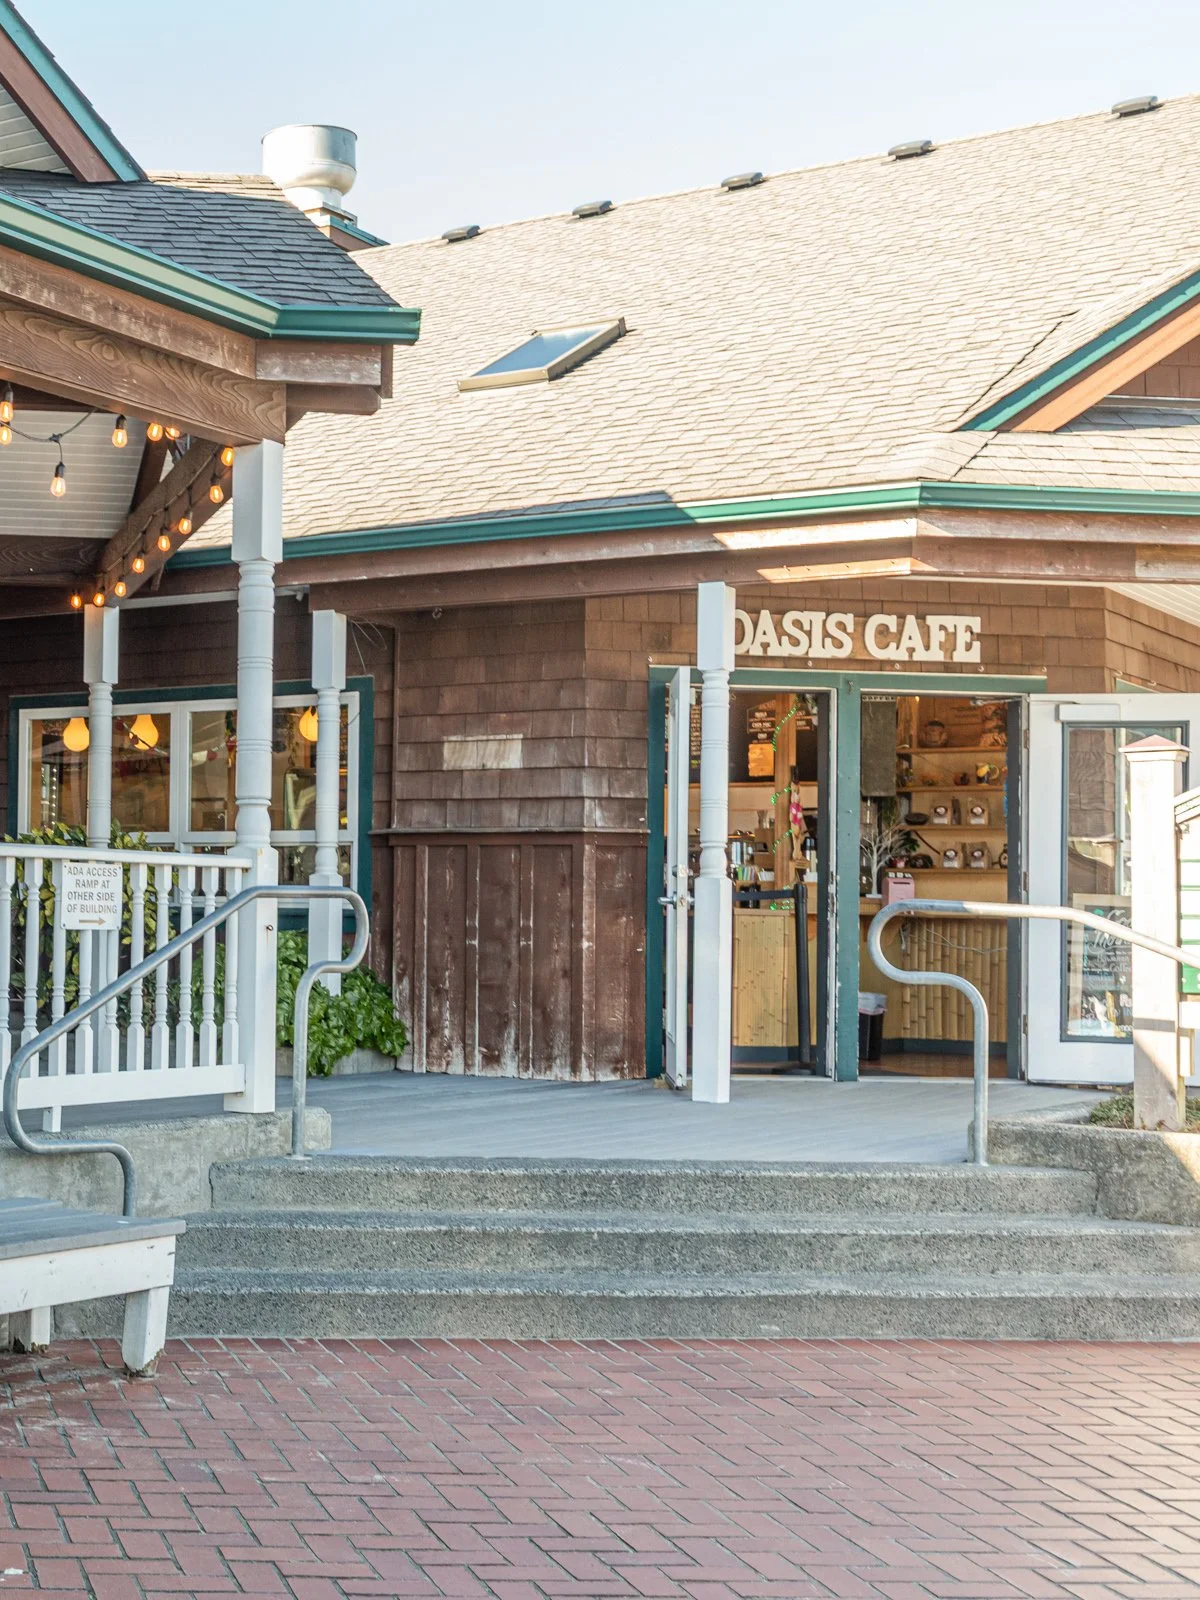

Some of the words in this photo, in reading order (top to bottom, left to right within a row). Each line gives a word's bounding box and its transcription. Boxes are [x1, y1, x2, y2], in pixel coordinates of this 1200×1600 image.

[864, 614, 982, 663] CAFE
[67, 866, 84, 876] ADA
[87, 867, 118, 877] ACCESS
[75, 879, 99, 889] RAMP
[102, 880, 110, 889] AT
[67, 891, 94, 901] OTHER
[96, 892, 115, 901] SIDE
[67, 904, 78, 913] OF
[80, 904, 118, 914] BUILDING
